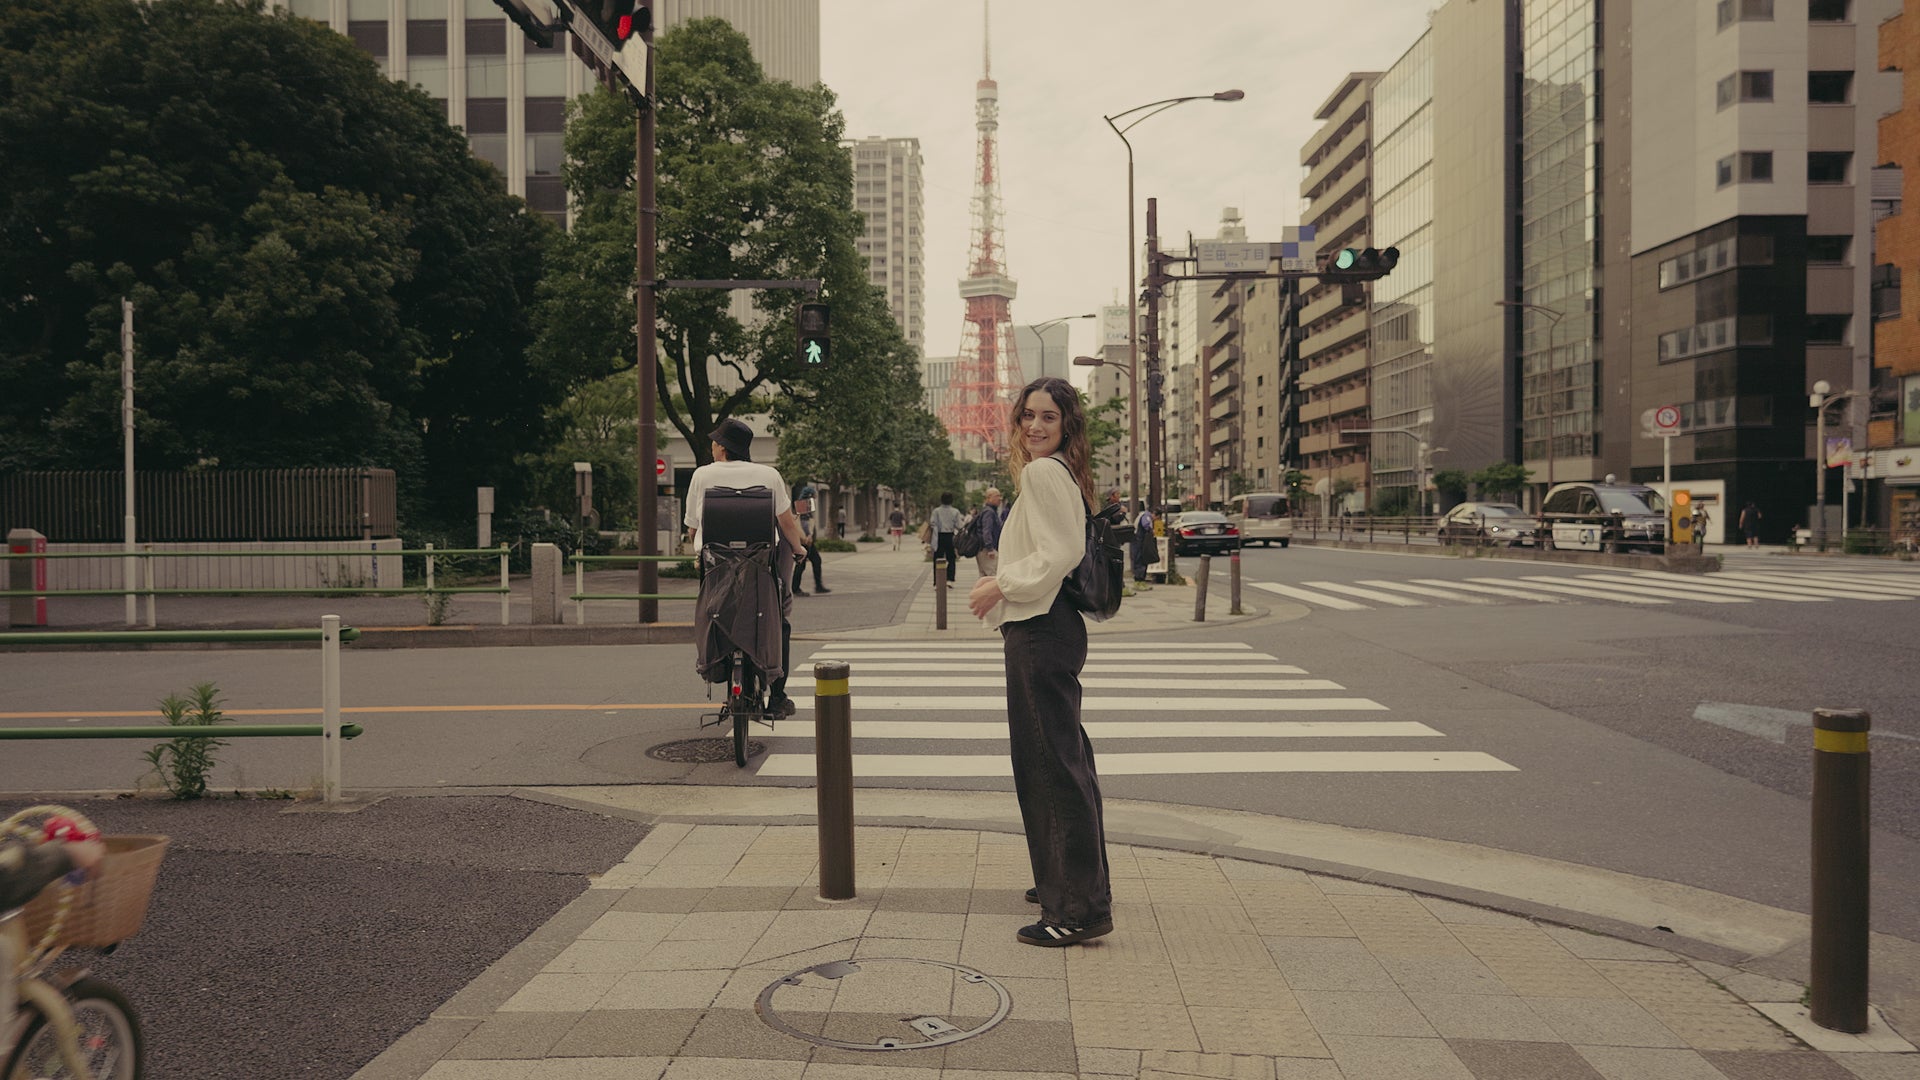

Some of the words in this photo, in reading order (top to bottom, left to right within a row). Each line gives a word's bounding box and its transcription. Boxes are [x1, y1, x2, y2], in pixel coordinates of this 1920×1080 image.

[1203, 248, 1264, 261] 三田一丁目
